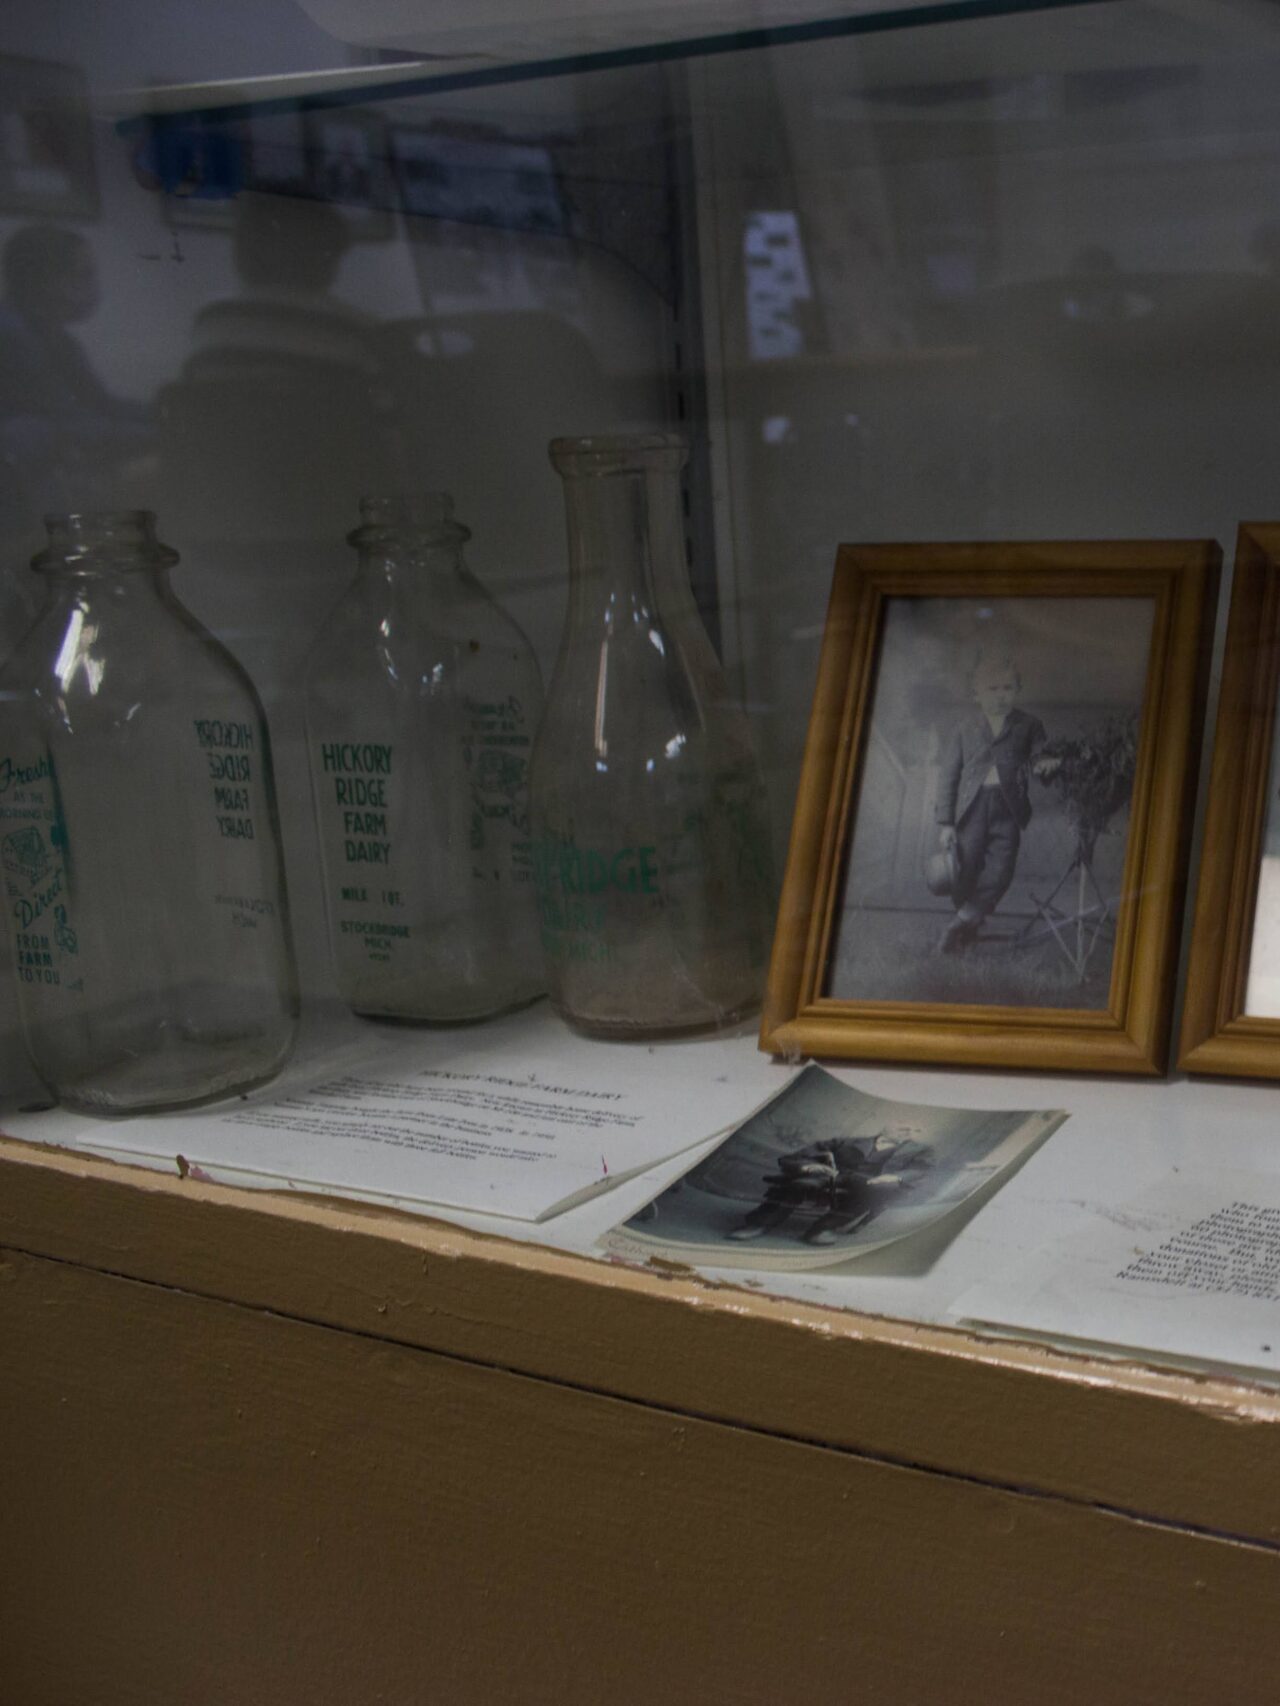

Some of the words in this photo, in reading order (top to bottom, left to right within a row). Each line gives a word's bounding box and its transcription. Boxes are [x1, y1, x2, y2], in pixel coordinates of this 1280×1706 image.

[321, 743, 392, 774] HICKORY
[334, 777, 388, 808] RIDGE
[343, 811, 387, 837] FARM
[344, 839, 391, 865] DAIRY
[341, 887, 367, 902] MILK
[16, 932, 49, 950] FROM
[18, 950, 52, 967] FARM
